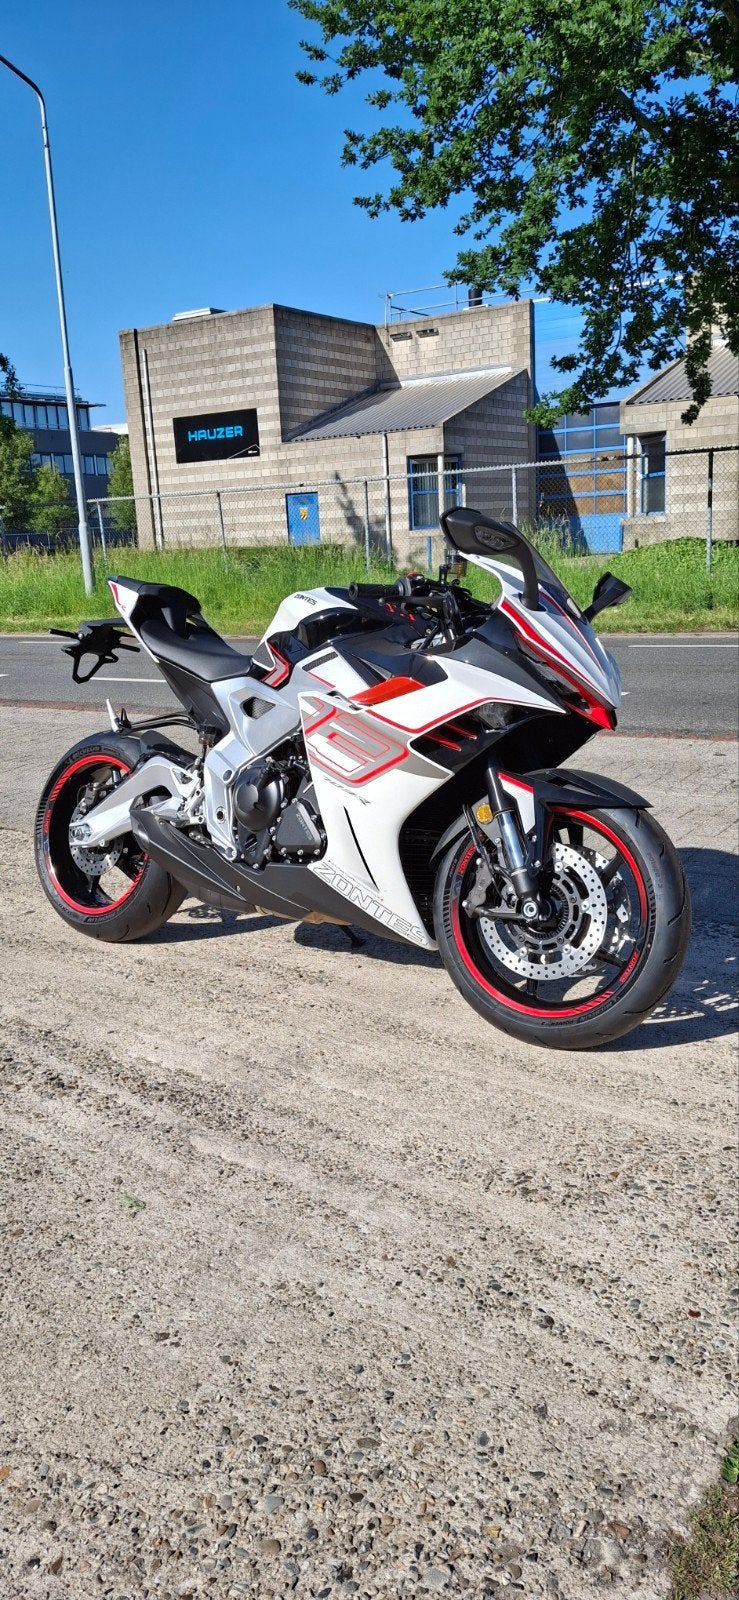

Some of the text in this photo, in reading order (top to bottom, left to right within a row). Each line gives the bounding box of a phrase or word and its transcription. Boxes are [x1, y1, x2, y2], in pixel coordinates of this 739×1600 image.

[188, 426, 243, 441] HAUZER
[294, 594, 317, 605] ZONTES
[313, 861, 429, 946] ZONTES
[620, 950, 640, 983] ZONTES
